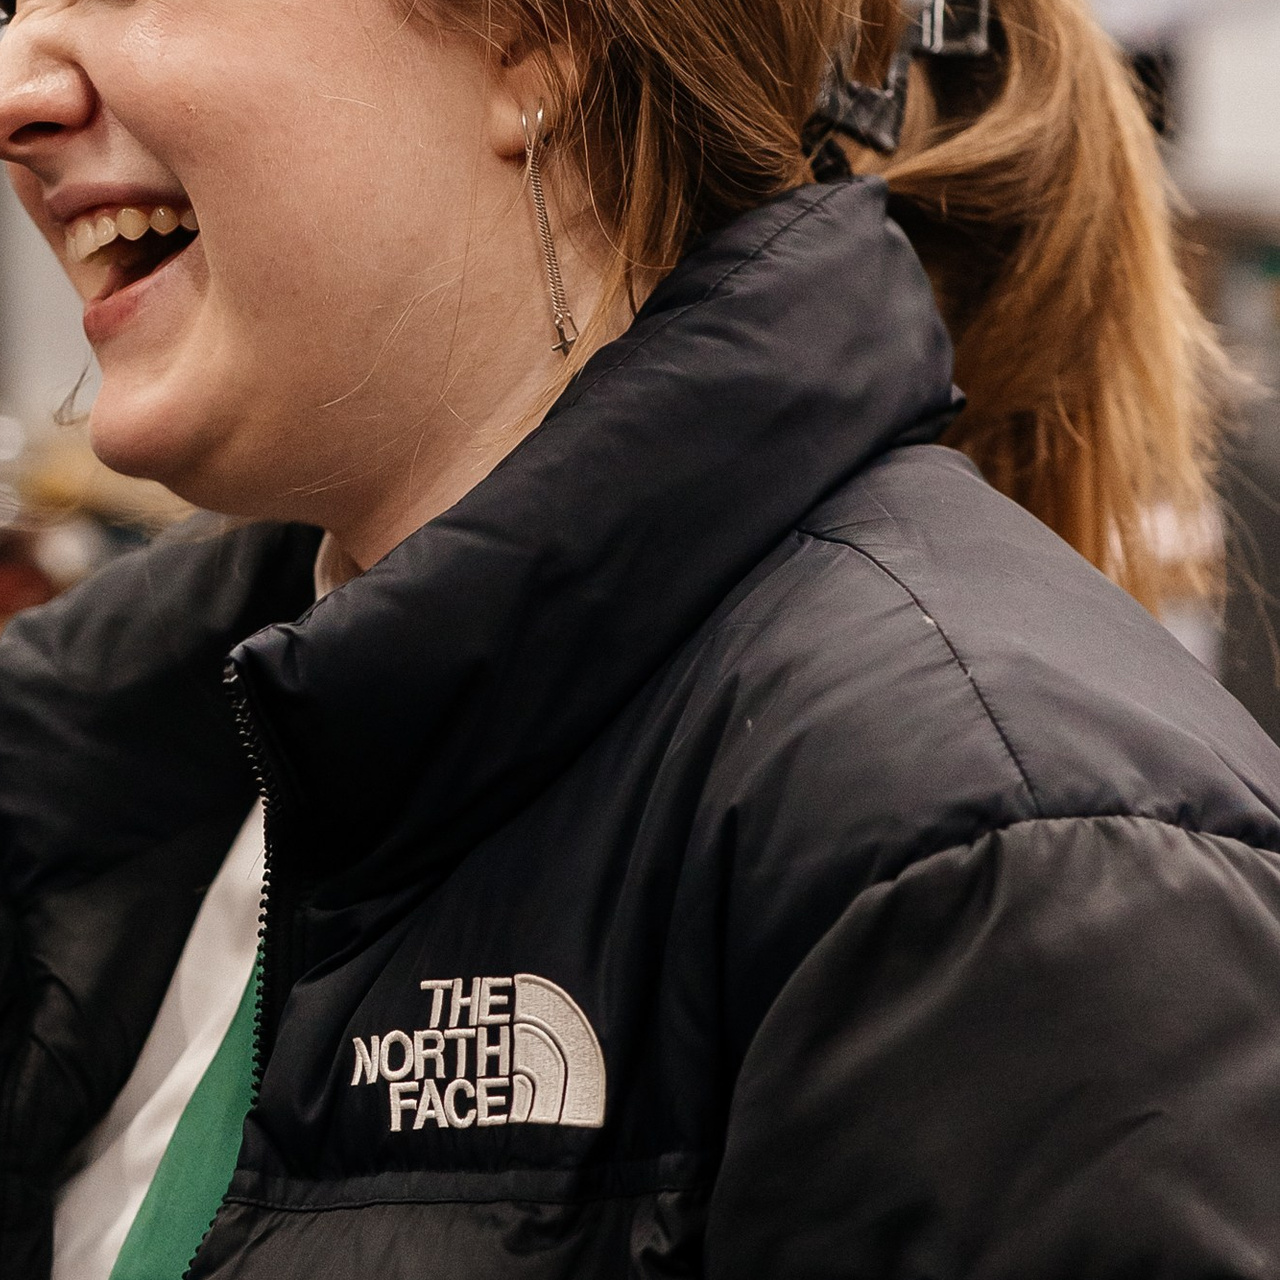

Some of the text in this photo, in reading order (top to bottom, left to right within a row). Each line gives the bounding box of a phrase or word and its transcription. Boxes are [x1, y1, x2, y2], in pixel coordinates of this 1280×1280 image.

[420, 977, 513, 1028] THE
[351, 1026, 510, 1086] NORTH
[390, 1077, 510, 1132] FACE
